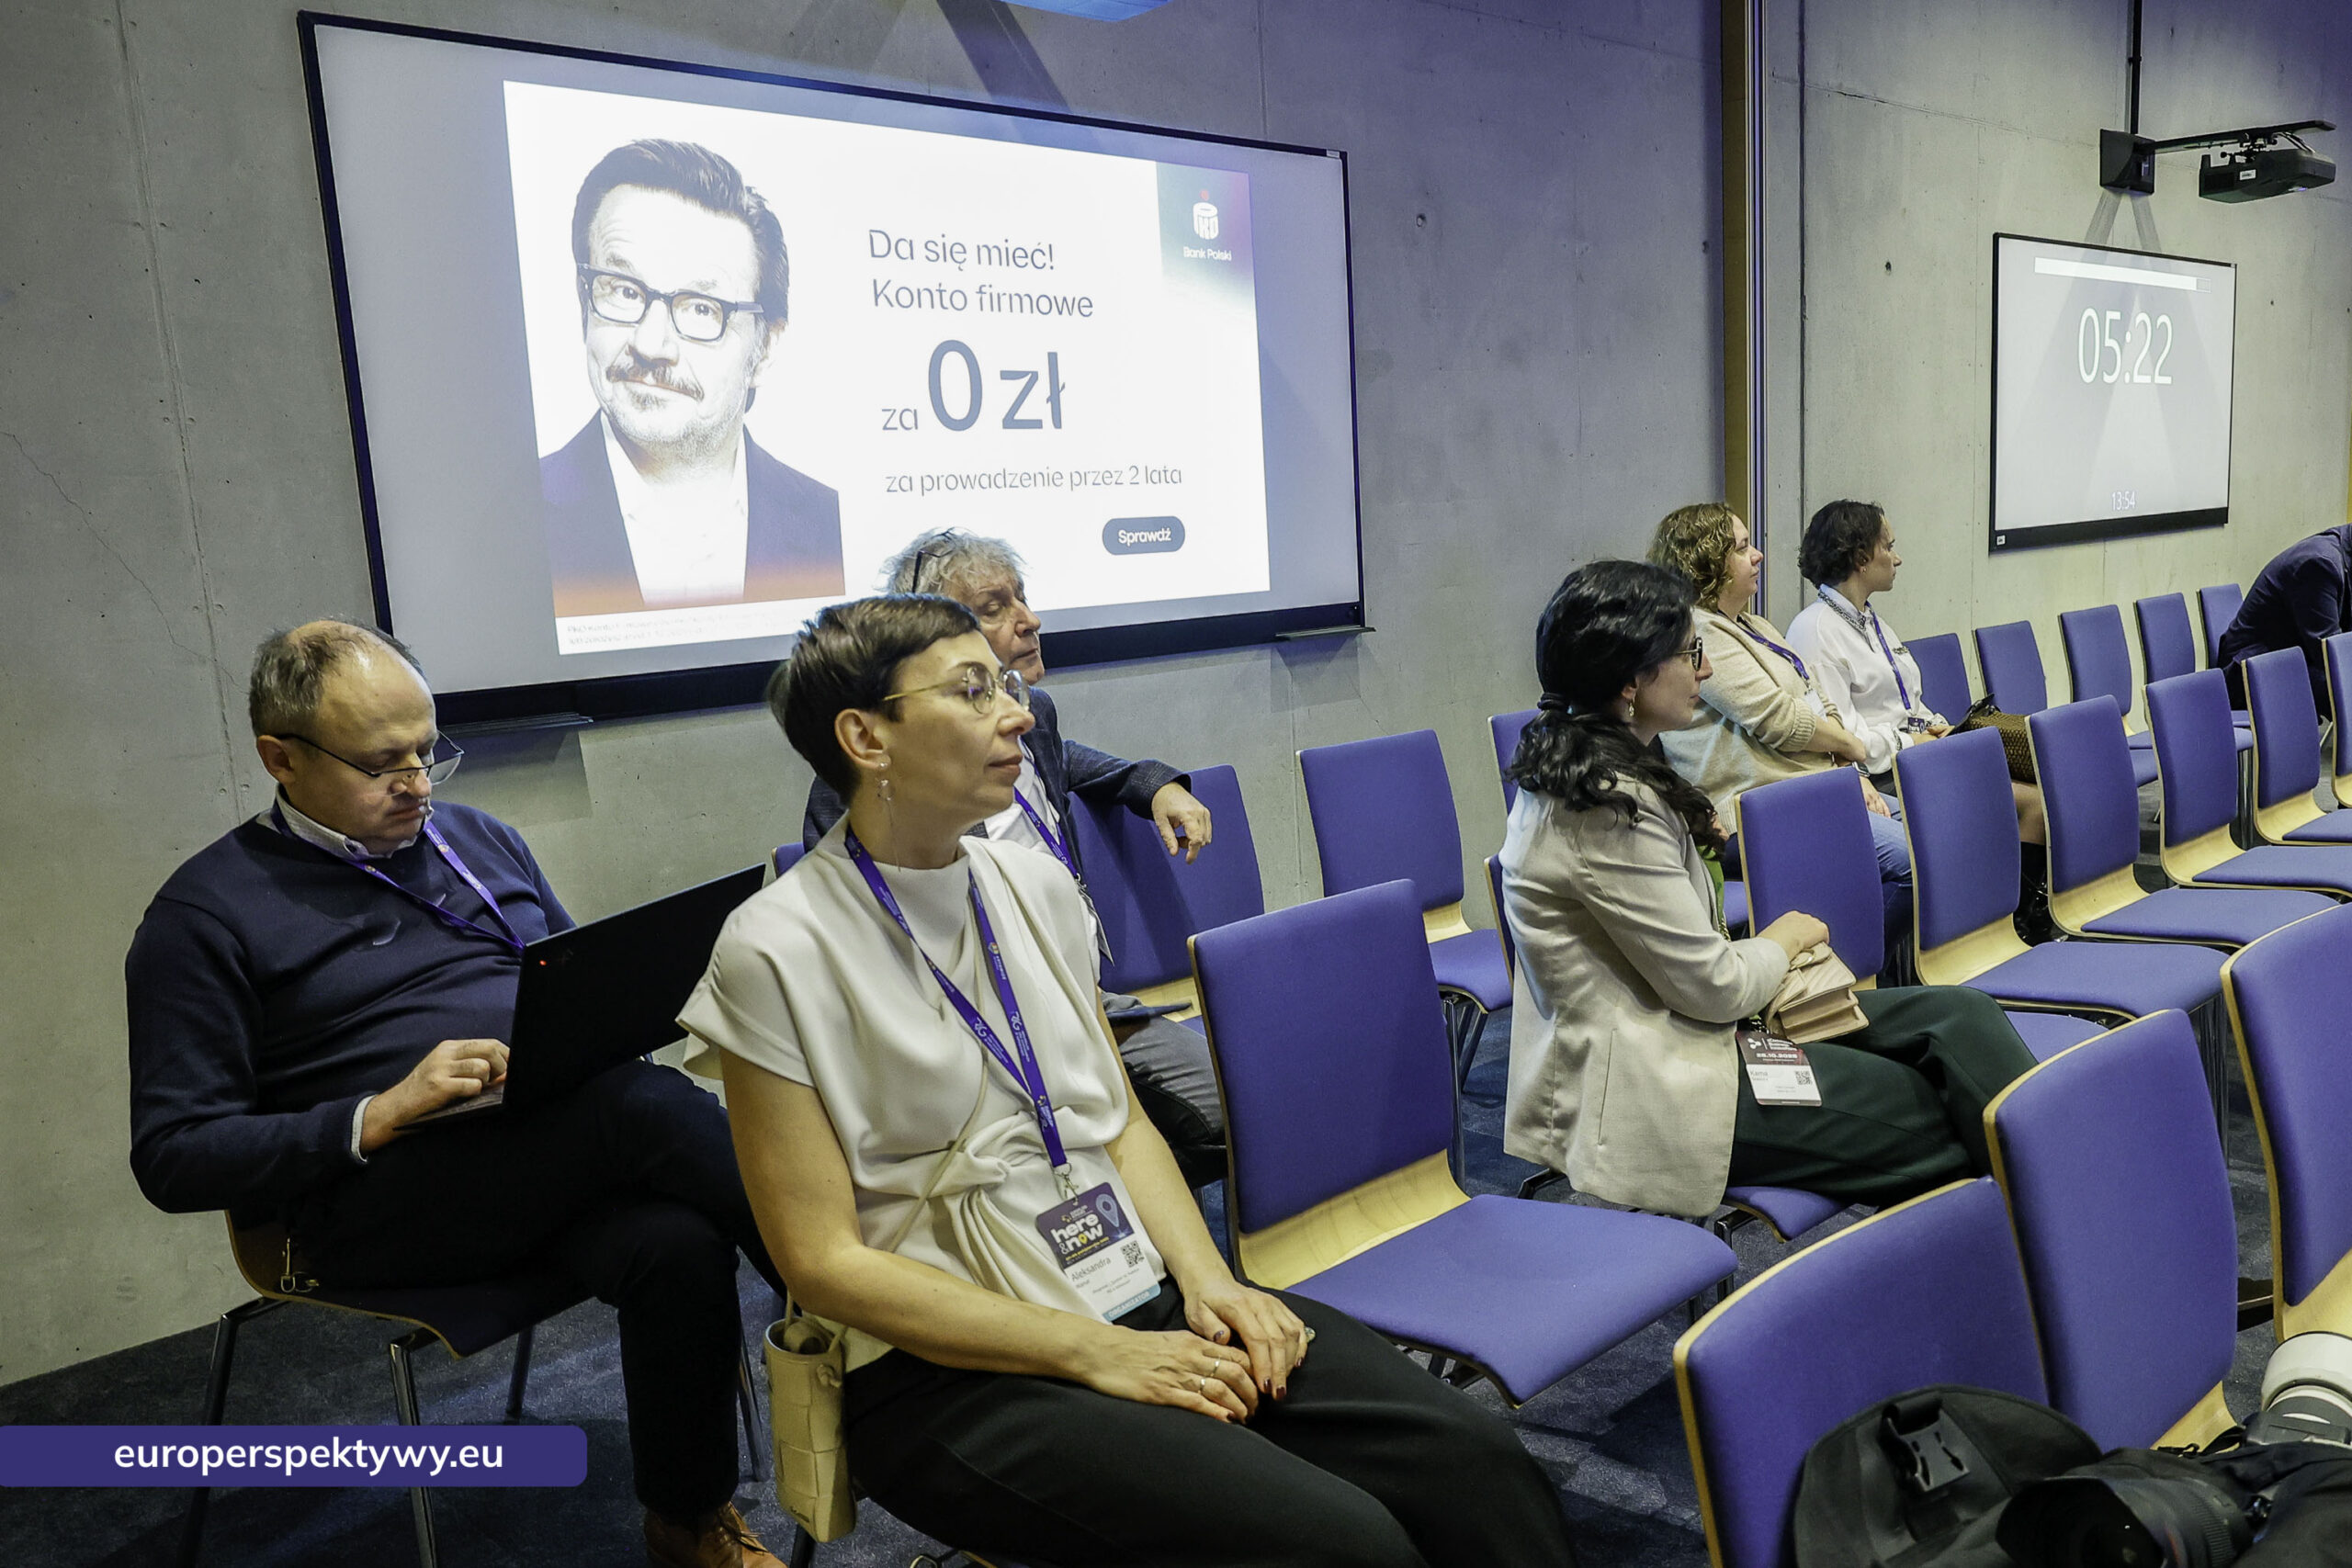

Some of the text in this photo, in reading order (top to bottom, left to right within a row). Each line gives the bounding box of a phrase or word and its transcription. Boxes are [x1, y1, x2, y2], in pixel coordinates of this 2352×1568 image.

[868, 228, 1055, 272] Da się mieć!
[1183, 246, 1232, 262] Bank Polski
[873, 278, 1094, 318] Konto firmowe
[2077, 307, 2174, 385] 05:22
[881, 339, 1067, 433] za 0 zł
[886, 465, 1182, 497] za prowadzenie przez 2 lata
[2111, 490, 2137, 511] 13:54
[1118, 527, 1172, 547] Sprawdź
[1049, 1213, 1100, 1245] here
[1071, 1256, 1113, 1283] Aleksandra
